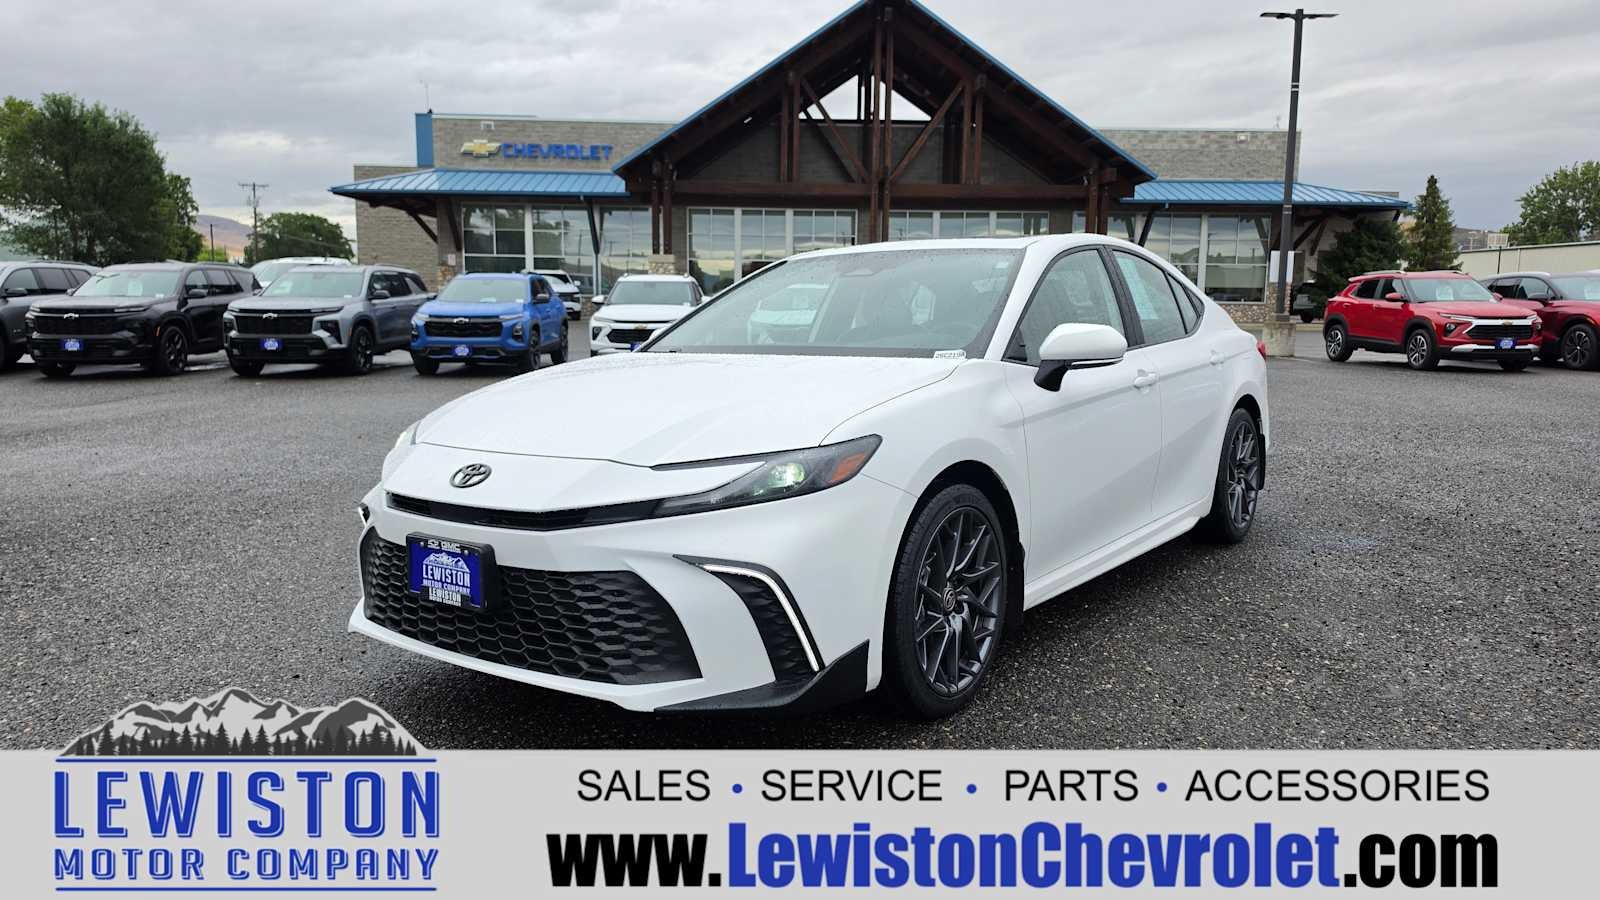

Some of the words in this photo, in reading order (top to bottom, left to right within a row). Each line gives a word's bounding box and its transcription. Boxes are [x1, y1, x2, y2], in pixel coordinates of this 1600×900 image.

[502, 143, 613, 161] CHEVROLET
[422, 564, 471, 587] LEWISTON
[429, 587, 461, 602] LEWISTON
